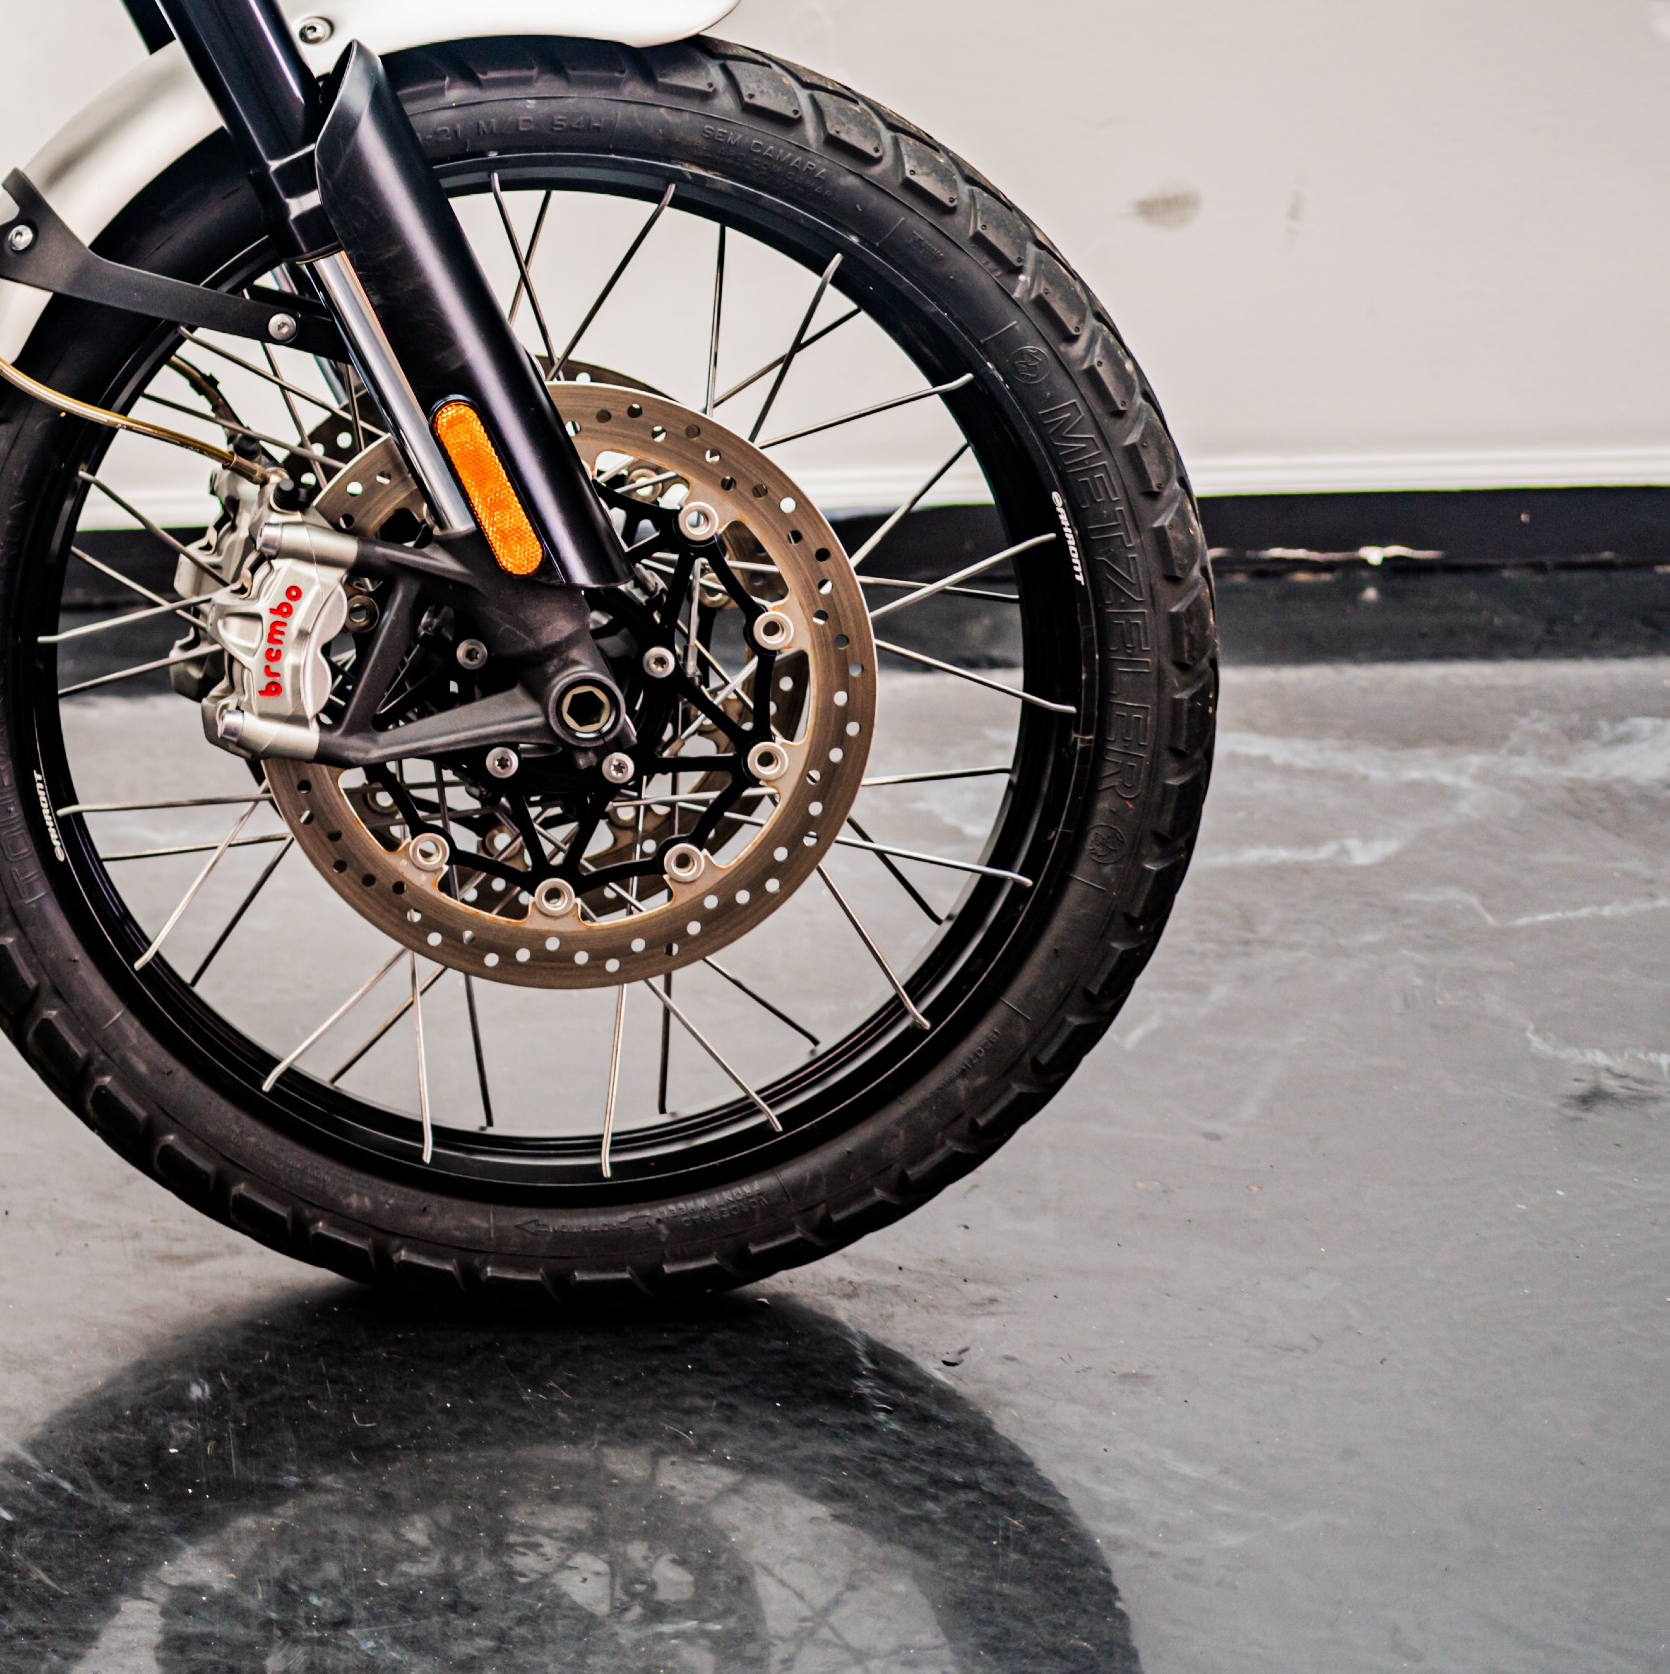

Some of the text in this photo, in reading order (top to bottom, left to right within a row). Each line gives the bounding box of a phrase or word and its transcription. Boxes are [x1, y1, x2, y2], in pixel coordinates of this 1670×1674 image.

[700, 122, 743, 147] SEM
[258, 585, 303, 699] brembo
[1039, 396, 1154, 802] METZELER
